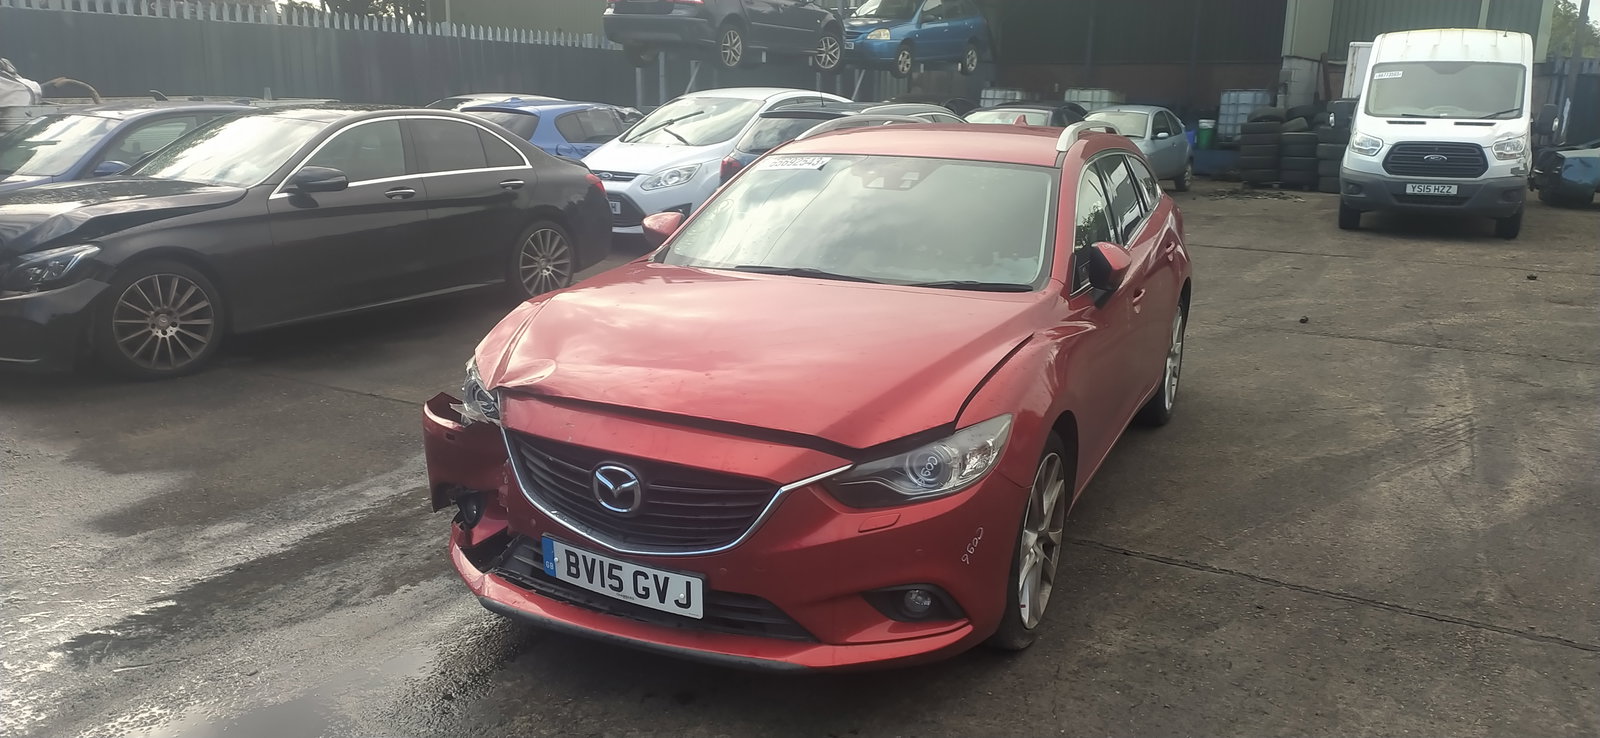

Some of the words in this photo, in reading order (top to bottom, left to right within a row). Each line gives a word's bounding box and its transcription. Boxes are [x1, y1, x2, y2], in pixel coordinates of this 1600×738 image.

[1411, 184, 1432, 193] YS15
[1433, 185, 1453, 194] HZZ
[565, 549, 624, 593] BV15
[632, 570, 692, 609] GVJ
